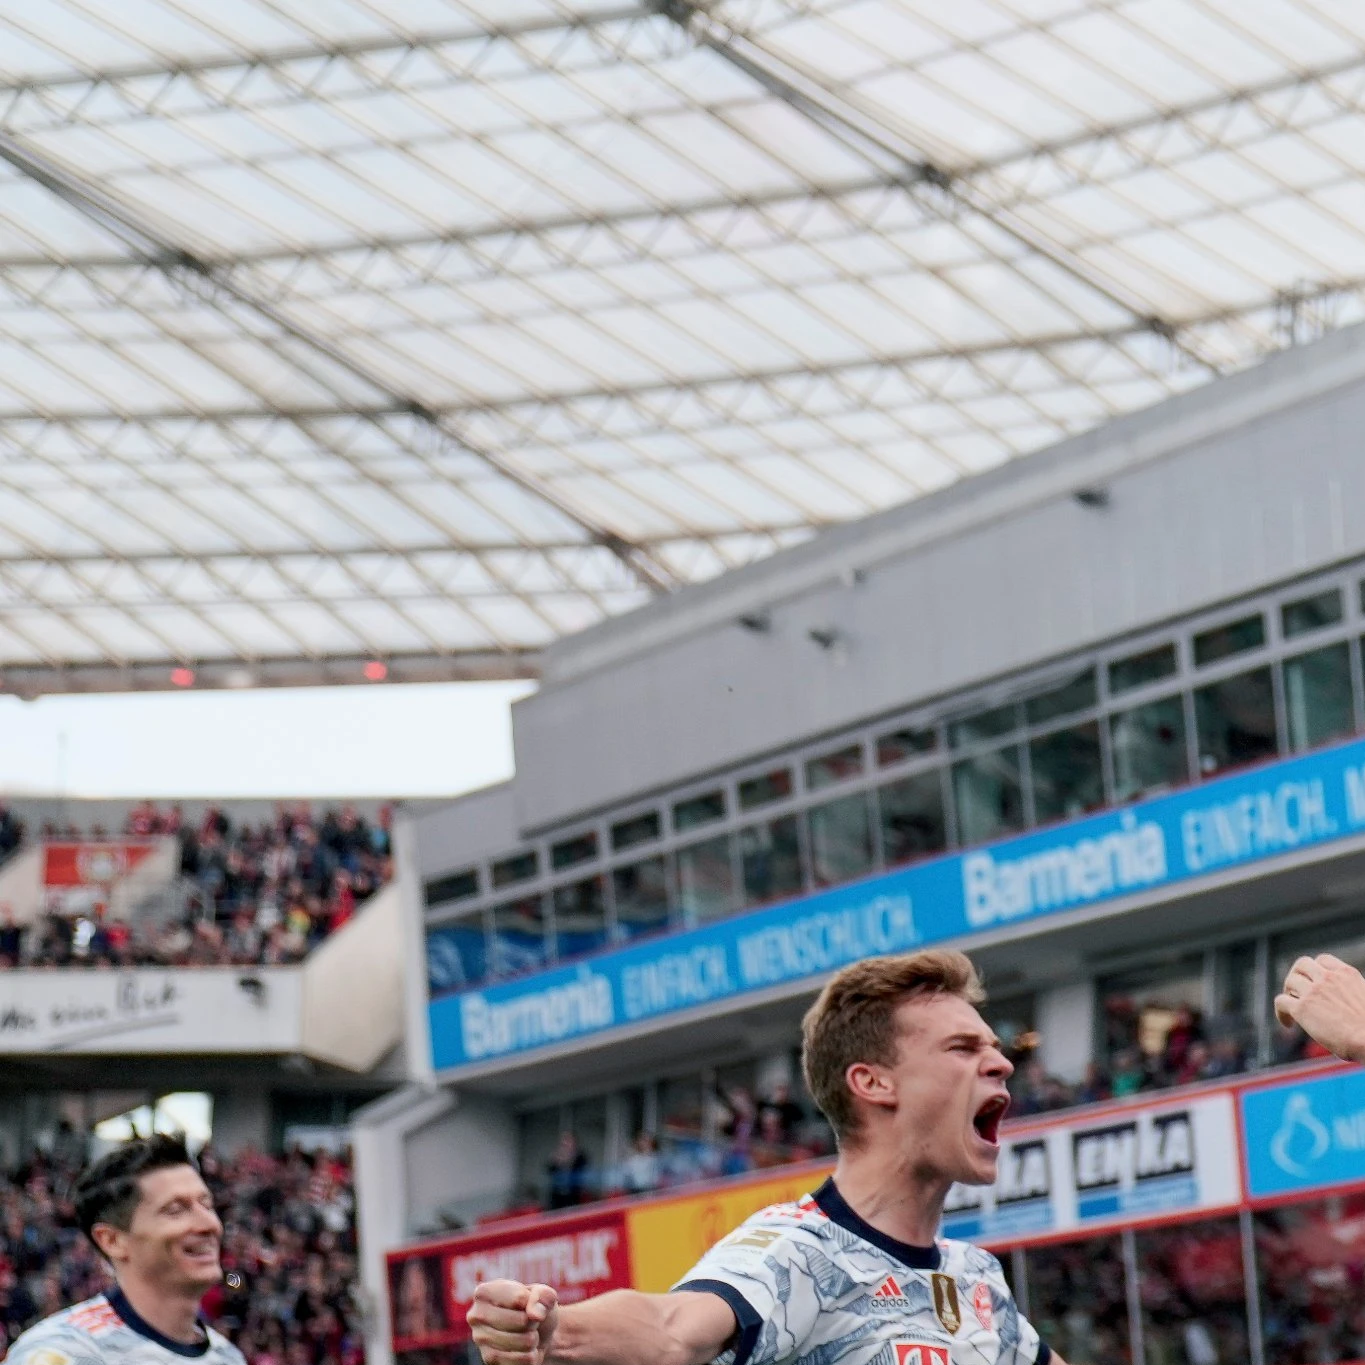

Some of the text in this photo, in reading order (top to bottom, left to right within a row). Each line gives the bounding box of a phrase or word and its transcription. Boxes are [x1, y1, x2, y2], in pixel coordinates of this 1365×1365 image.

[963, 813, 1167, 928] Barmenia
[1182, 779, 1338, 872] EINFACH.
[460, 962, 614, 1060] Barmenia
[870, 1297, 909, 1308] adidas
